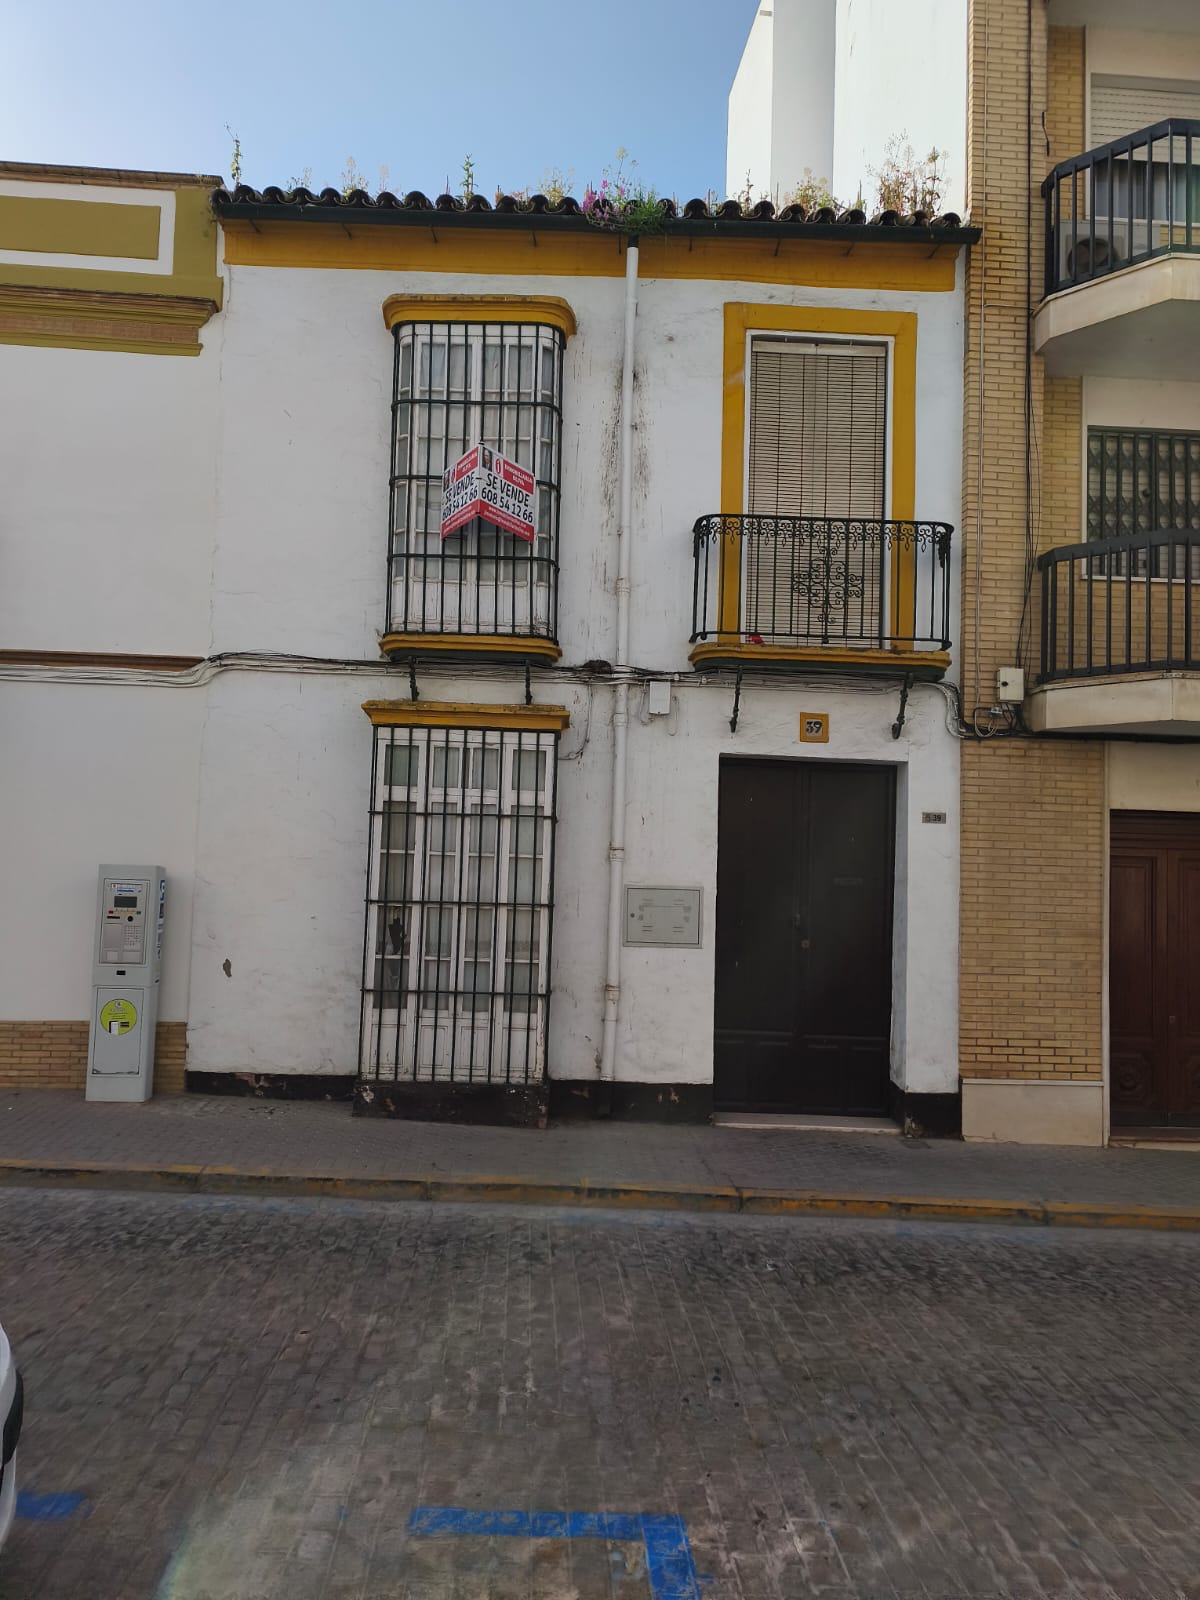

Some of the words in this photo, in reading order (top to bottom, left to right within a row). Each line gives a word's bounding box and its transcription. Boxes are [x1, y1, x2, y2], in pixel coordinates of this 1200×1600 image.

[481, 487, 498, 505] 608
[500, 497, 510, 512] 54
[511, 503, 521, 518] 12
[522, 510, 533, 523] 66
[486, 473, 498, 490] SE
[500, 479, 530, 507] VENDE
[806, 720, 823, 734] 39
